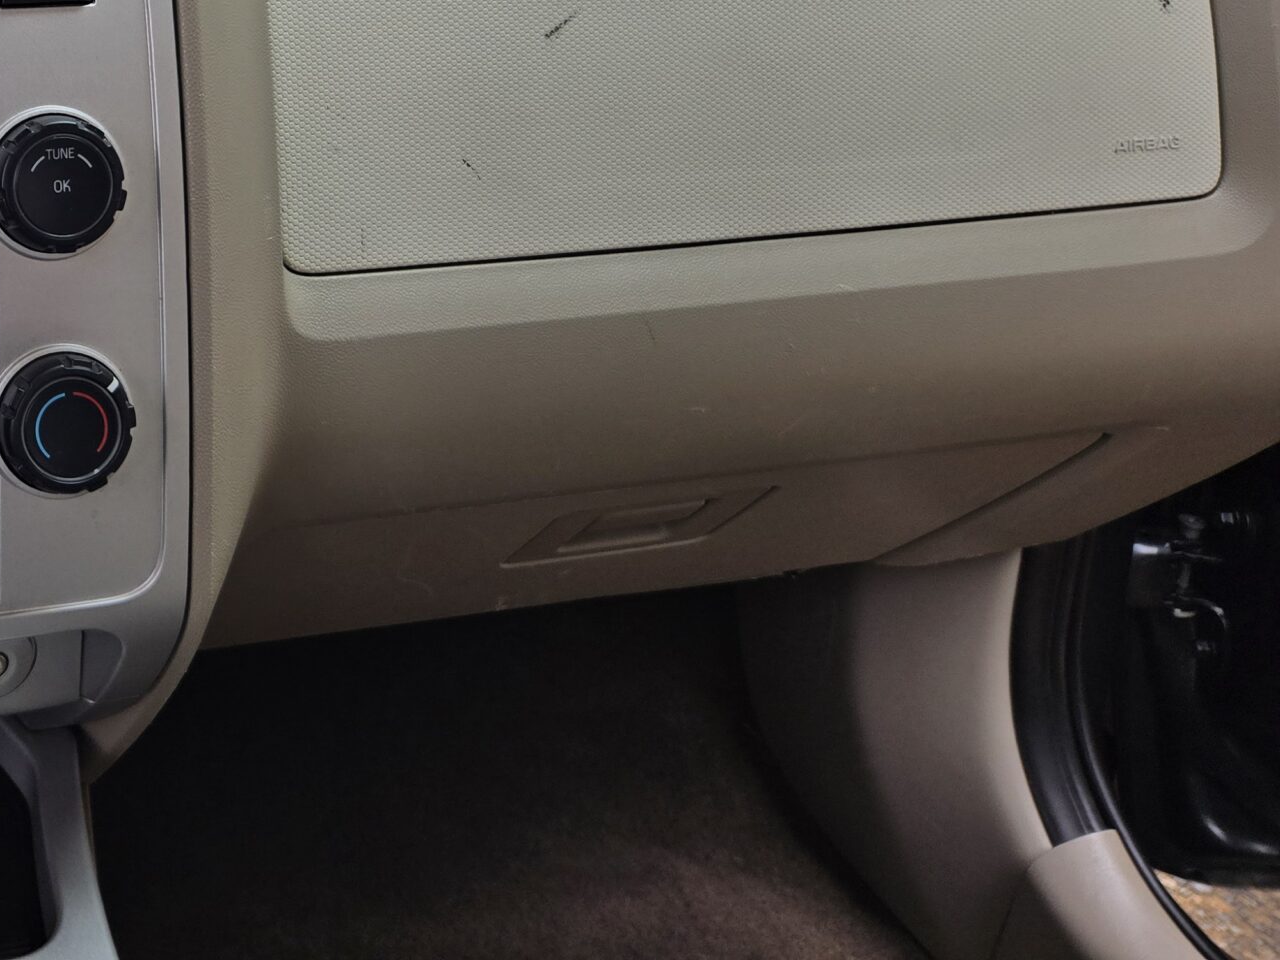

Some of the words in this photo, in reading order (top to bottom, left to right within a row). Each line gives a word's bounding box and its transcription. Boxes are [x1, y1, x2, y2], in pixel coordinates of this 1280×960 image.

[1113, 136, 1180, 153] AIRBAG
[45, 147, 75, 160] TUNE
[53, 179, 71, 193] OK
